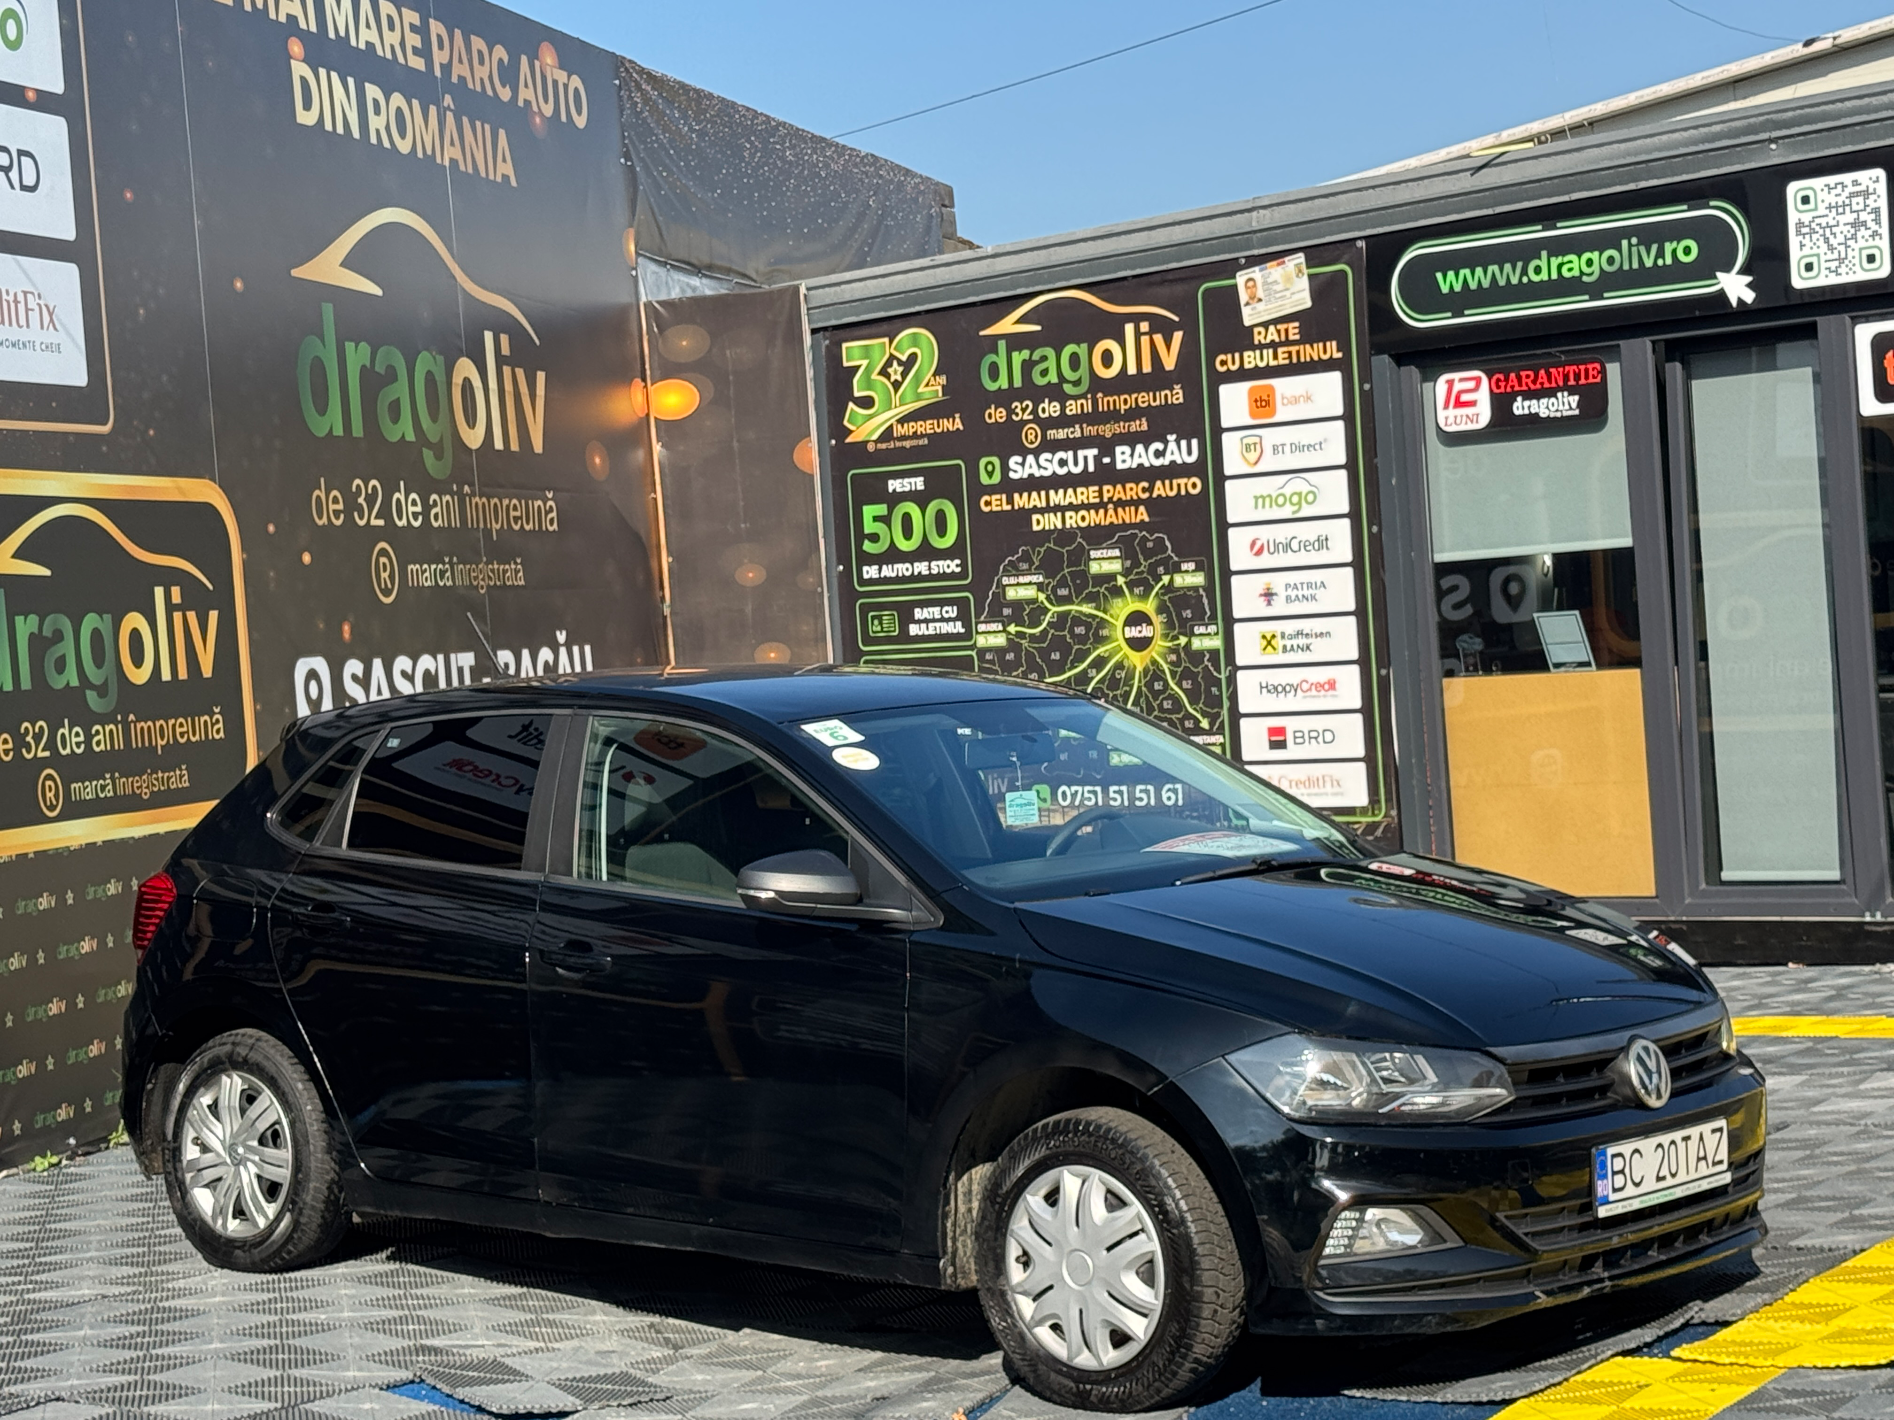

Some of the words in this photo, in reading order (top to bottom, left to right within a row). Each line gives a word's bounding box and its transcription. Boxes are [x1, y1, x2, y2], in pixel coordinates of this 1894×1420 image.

[428, 17, 513, 103] PARC
[517, 53, 590, 130] AUTO
[290, 58, 361, 141] DIN
[364, 82, 518, 188] ROMÂNIA
[1435, 236, 1699, 294] www.dragoliv.ro
[1253, 321, 1301, 345] RATE
[980, 320, 1185, 397] dragoliv
[1214, 353, 1241, 372] CU
[1243, 340, 1343, 370] BULETINUL
[297, 302, 546, 480] dragoliv
[842, 327, 943, 430] 32
[1490, 362, 1603, 393] GARANTIE
[984, 404, 1008, 424] de
[1011, 401, 1034, 421] 32
[1037, 399, 1062, 420] de
[1065, 392, 1092, 416] ani
[1096, 384, 1184, 414] împreună
[1253, 394, 1271, 409] tbi
[1281, 391, 1314, 407] bank
[1442, 376, 1483, 411] 12
[1512, 391, 1580, 418] dragoliv
[892, 412, 964, 439] ÎMPREUNĂ
[1046, 423, 1081, 442] marcă
[1082, 417, 1149, 439] înregistrată
[1444, 413, 1480, 427] LUNI
[1008, 447, 1099, 480] SASCUT
[1114, 435, 1200, 471] BACĂU
[1272, 443, 1287, 456] BT
[887, 476, 925, 494] PESTE
[979, 494, 1011, 513] CEL
[1012, 491, 1047, 511] MAI
[1048, 486, 1101, 508] MARE
[1102, 481, 1151, 502] PARC
[1152, 476, 1203, 499] AUTO
[311, 476, 344, 527] de
[352, 477, 385, 527] 32
[392, 479, 423, 529] de
[430, 483, 460, 529] ani
[465, 484, 558, 541] împreună
[1253, 489, 1318, 516] mogo
[862, 498, 960, 555] 500
[1031, 513, 1063, 532] DIN
[1065, 504, 1151, 529] ROMÂNIA
[1266, 534, 1331, 555] UniCredit
[407, 556, 453, 588] marcă
[454, 556, 526, 594] înregistrată
[862, 565, 880, 580] DE
[880, 562, 913, 578] AUTO
[914, 561, 930, 576] PE
[931, 559, 962, 575] STOC
[1284, 580, 1327, 592] PATRIA
[1285, 592, 1319, 604] BANK
[914, 607, 940, 621] RATE
[942, 606, 958, 619] CU
[909, 621, 965, 636] BULETINUL
[1124, 623, 1154, 639] BACĂU
[1280, 629, 1332, 641] Raiffeisen
[1281, 642, 1314, 654] BANK
[1259, 678, 1338, 698] HappyCredit
[20, 720, 51, 760] 32
[57, 717, 86, 757] de
[92, 713, 125, 754] ani
[127, 705, 226, 756] împreună
[1293, 729, 1336, 745] BRD
[70, 772, 114, 802] marcă
[114, 763, 191, 800] înregistrată
[1057, 785, 1103, 807] 0751
[1108, 785, 1130, 807] 51
[1134, 784, 1155, 807] 51
[1161, 784, 1183, 806] 61
[1611, 1147, 1645, 1194] BC
[1653, 1126, 1725, 1184] 20TAZ
[1597, 1179, 1608, 1198] RO
